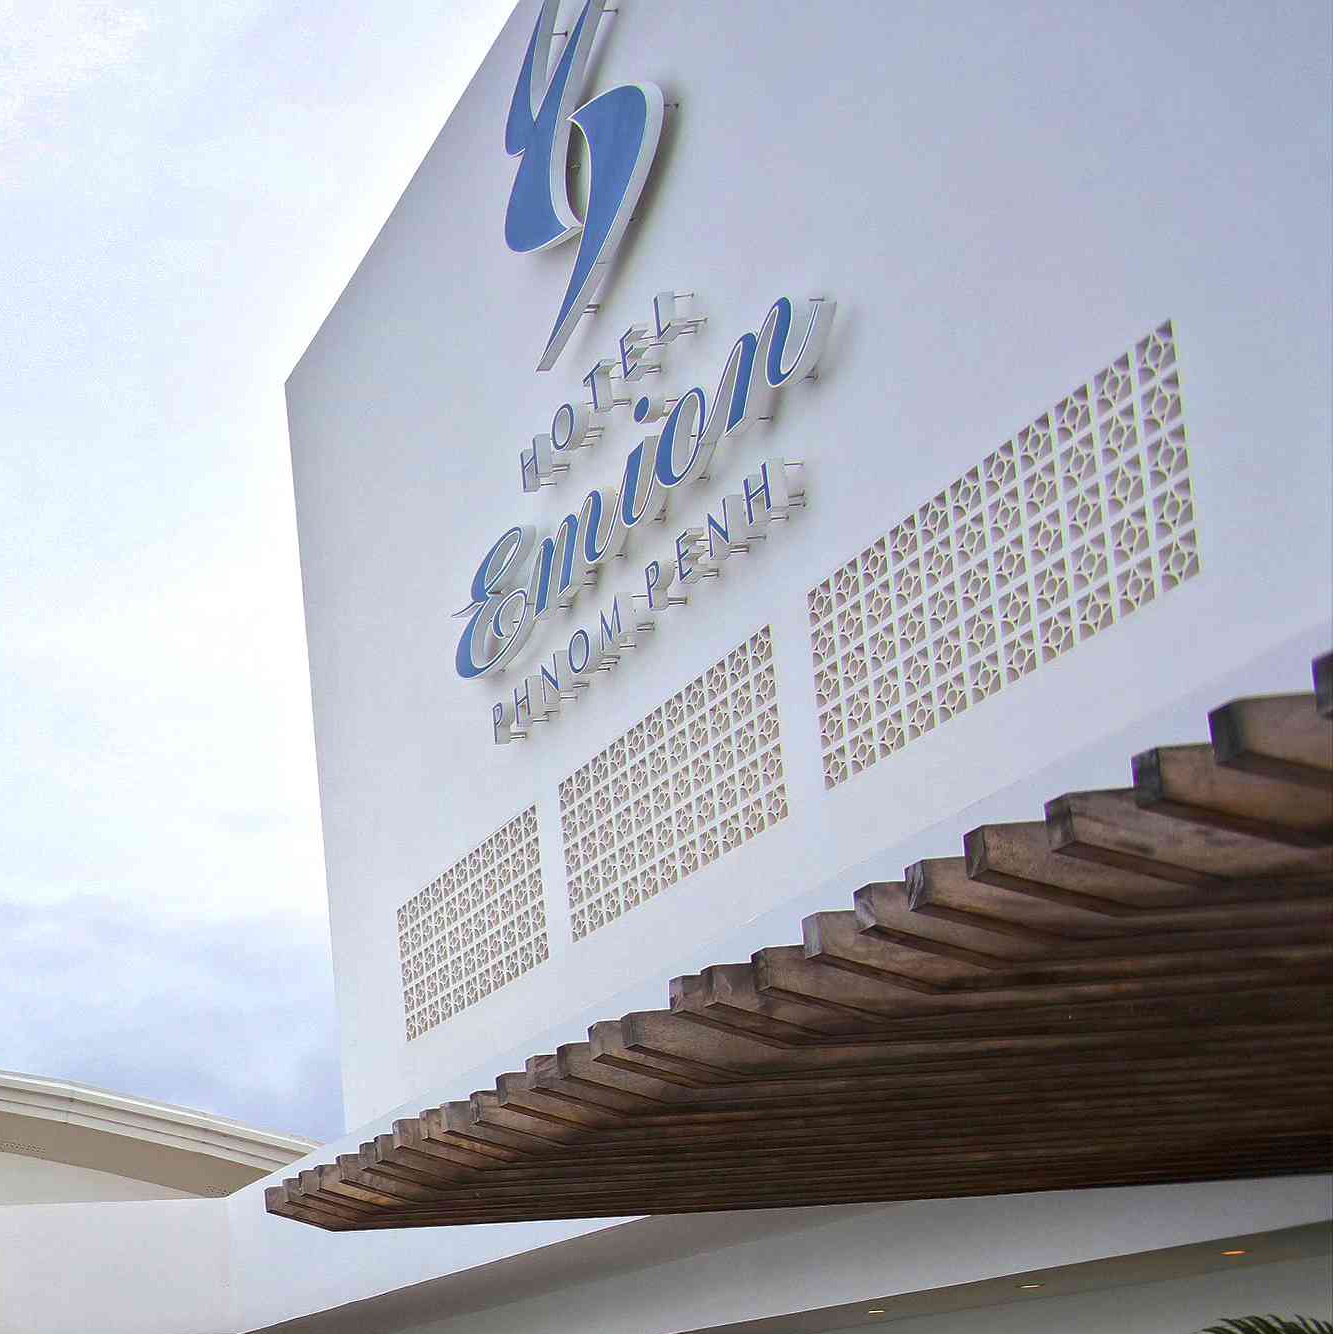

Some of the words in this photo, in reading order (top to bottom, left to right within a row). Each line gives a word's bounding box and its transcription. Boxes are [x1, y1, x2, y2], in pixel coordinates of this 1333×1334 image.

[452, 296, 829, 680] Emion
[519, 292, 675, 493] HOTEL
[492, 593, 623, 744] PHNOM
[644, 460, 779, 610] PENH
